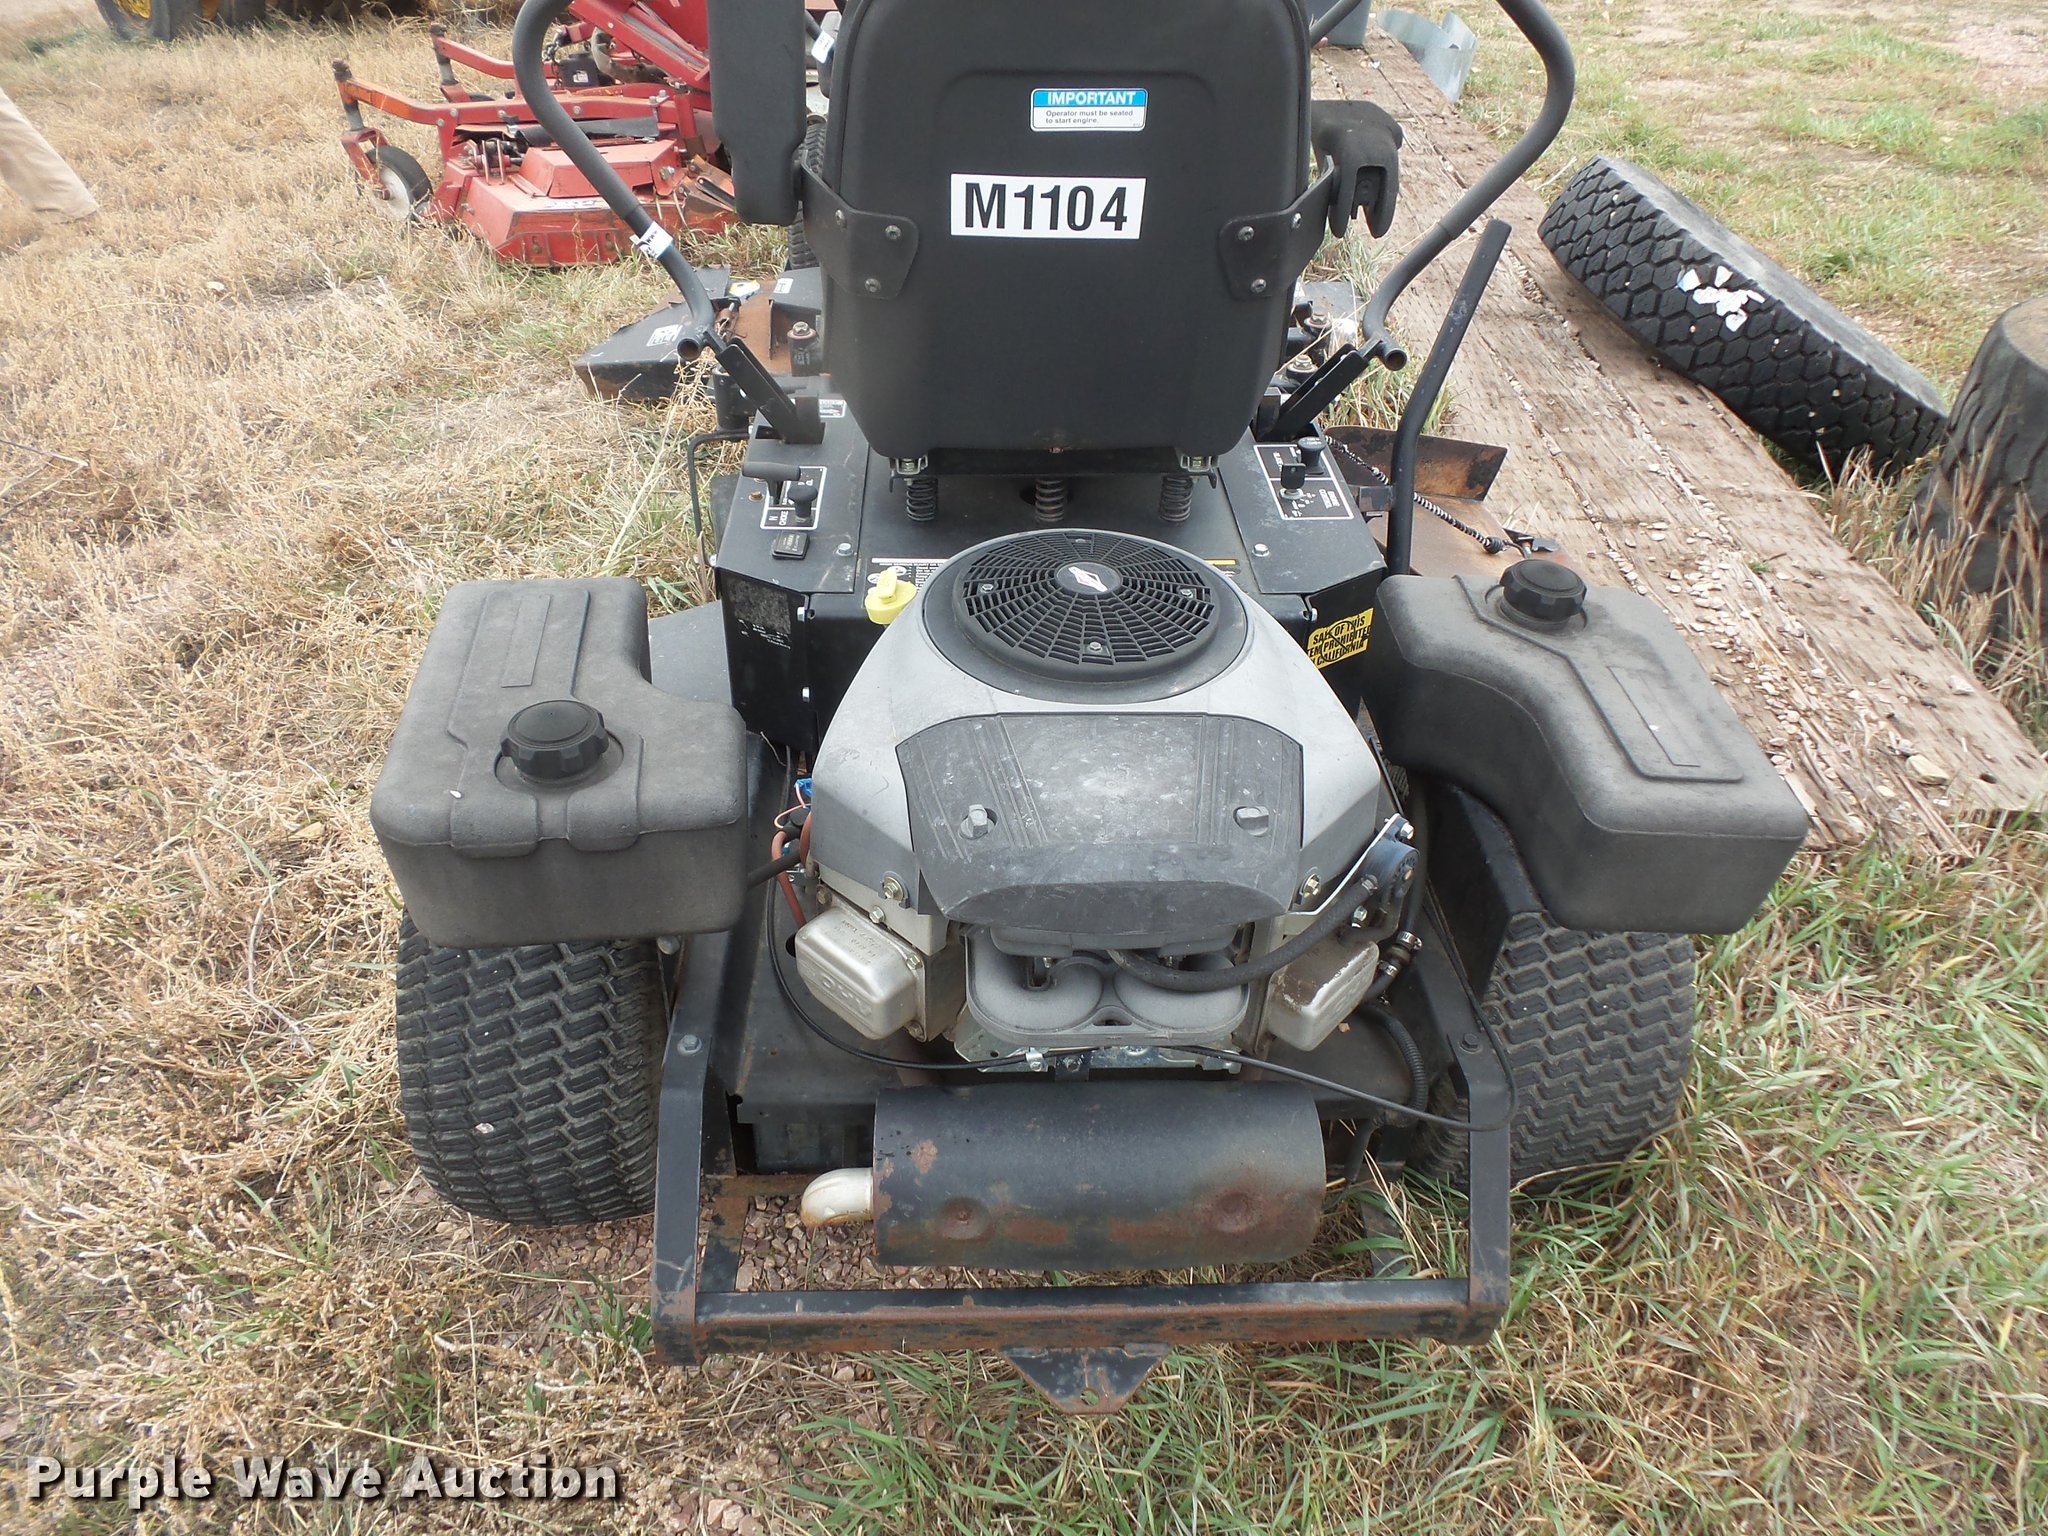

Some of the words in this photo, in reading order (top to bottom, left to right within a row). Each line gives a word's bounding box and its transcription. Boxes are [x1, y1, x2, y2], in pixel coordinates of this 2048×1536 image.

[1048, 91, 1136, 105] IMPORTANT
[1046, 110, 1077, 118] Operator
[965, 182, 1127, 231] M1104
[1334, 623, 1346, 637] OF
[1347, 616, 1365, 631] THIS
